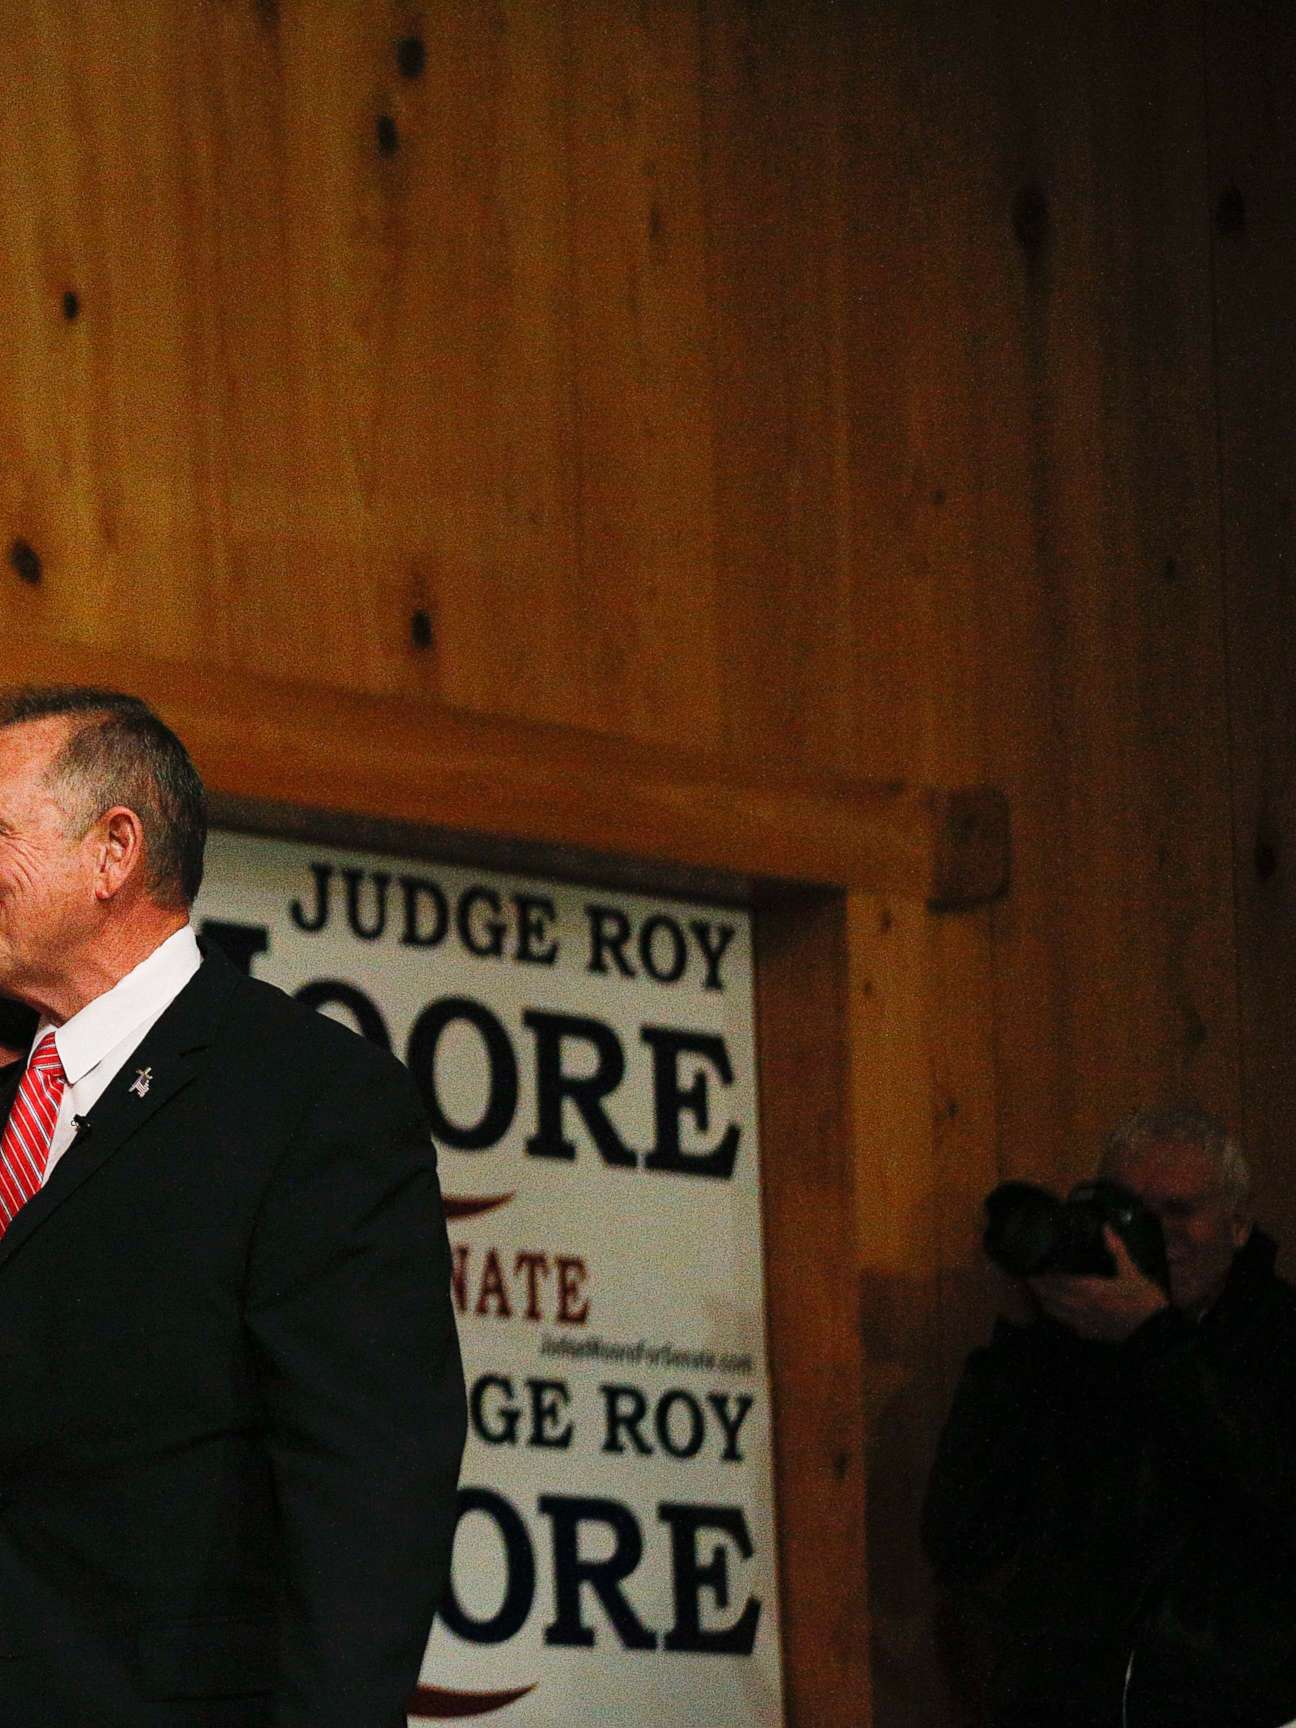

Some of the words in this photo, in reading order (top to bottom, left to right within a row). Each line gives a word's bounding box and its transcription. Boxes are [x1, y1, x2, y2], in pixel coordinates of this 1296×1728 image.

[291, 862, 560, 965] JUDGE
[585, 904, 736, 992] ROY
[470, 1373, 574, 1450] GE
[600, 1383, 753, 1462] ROY
[437, 1486, 761, 1655] ORE
